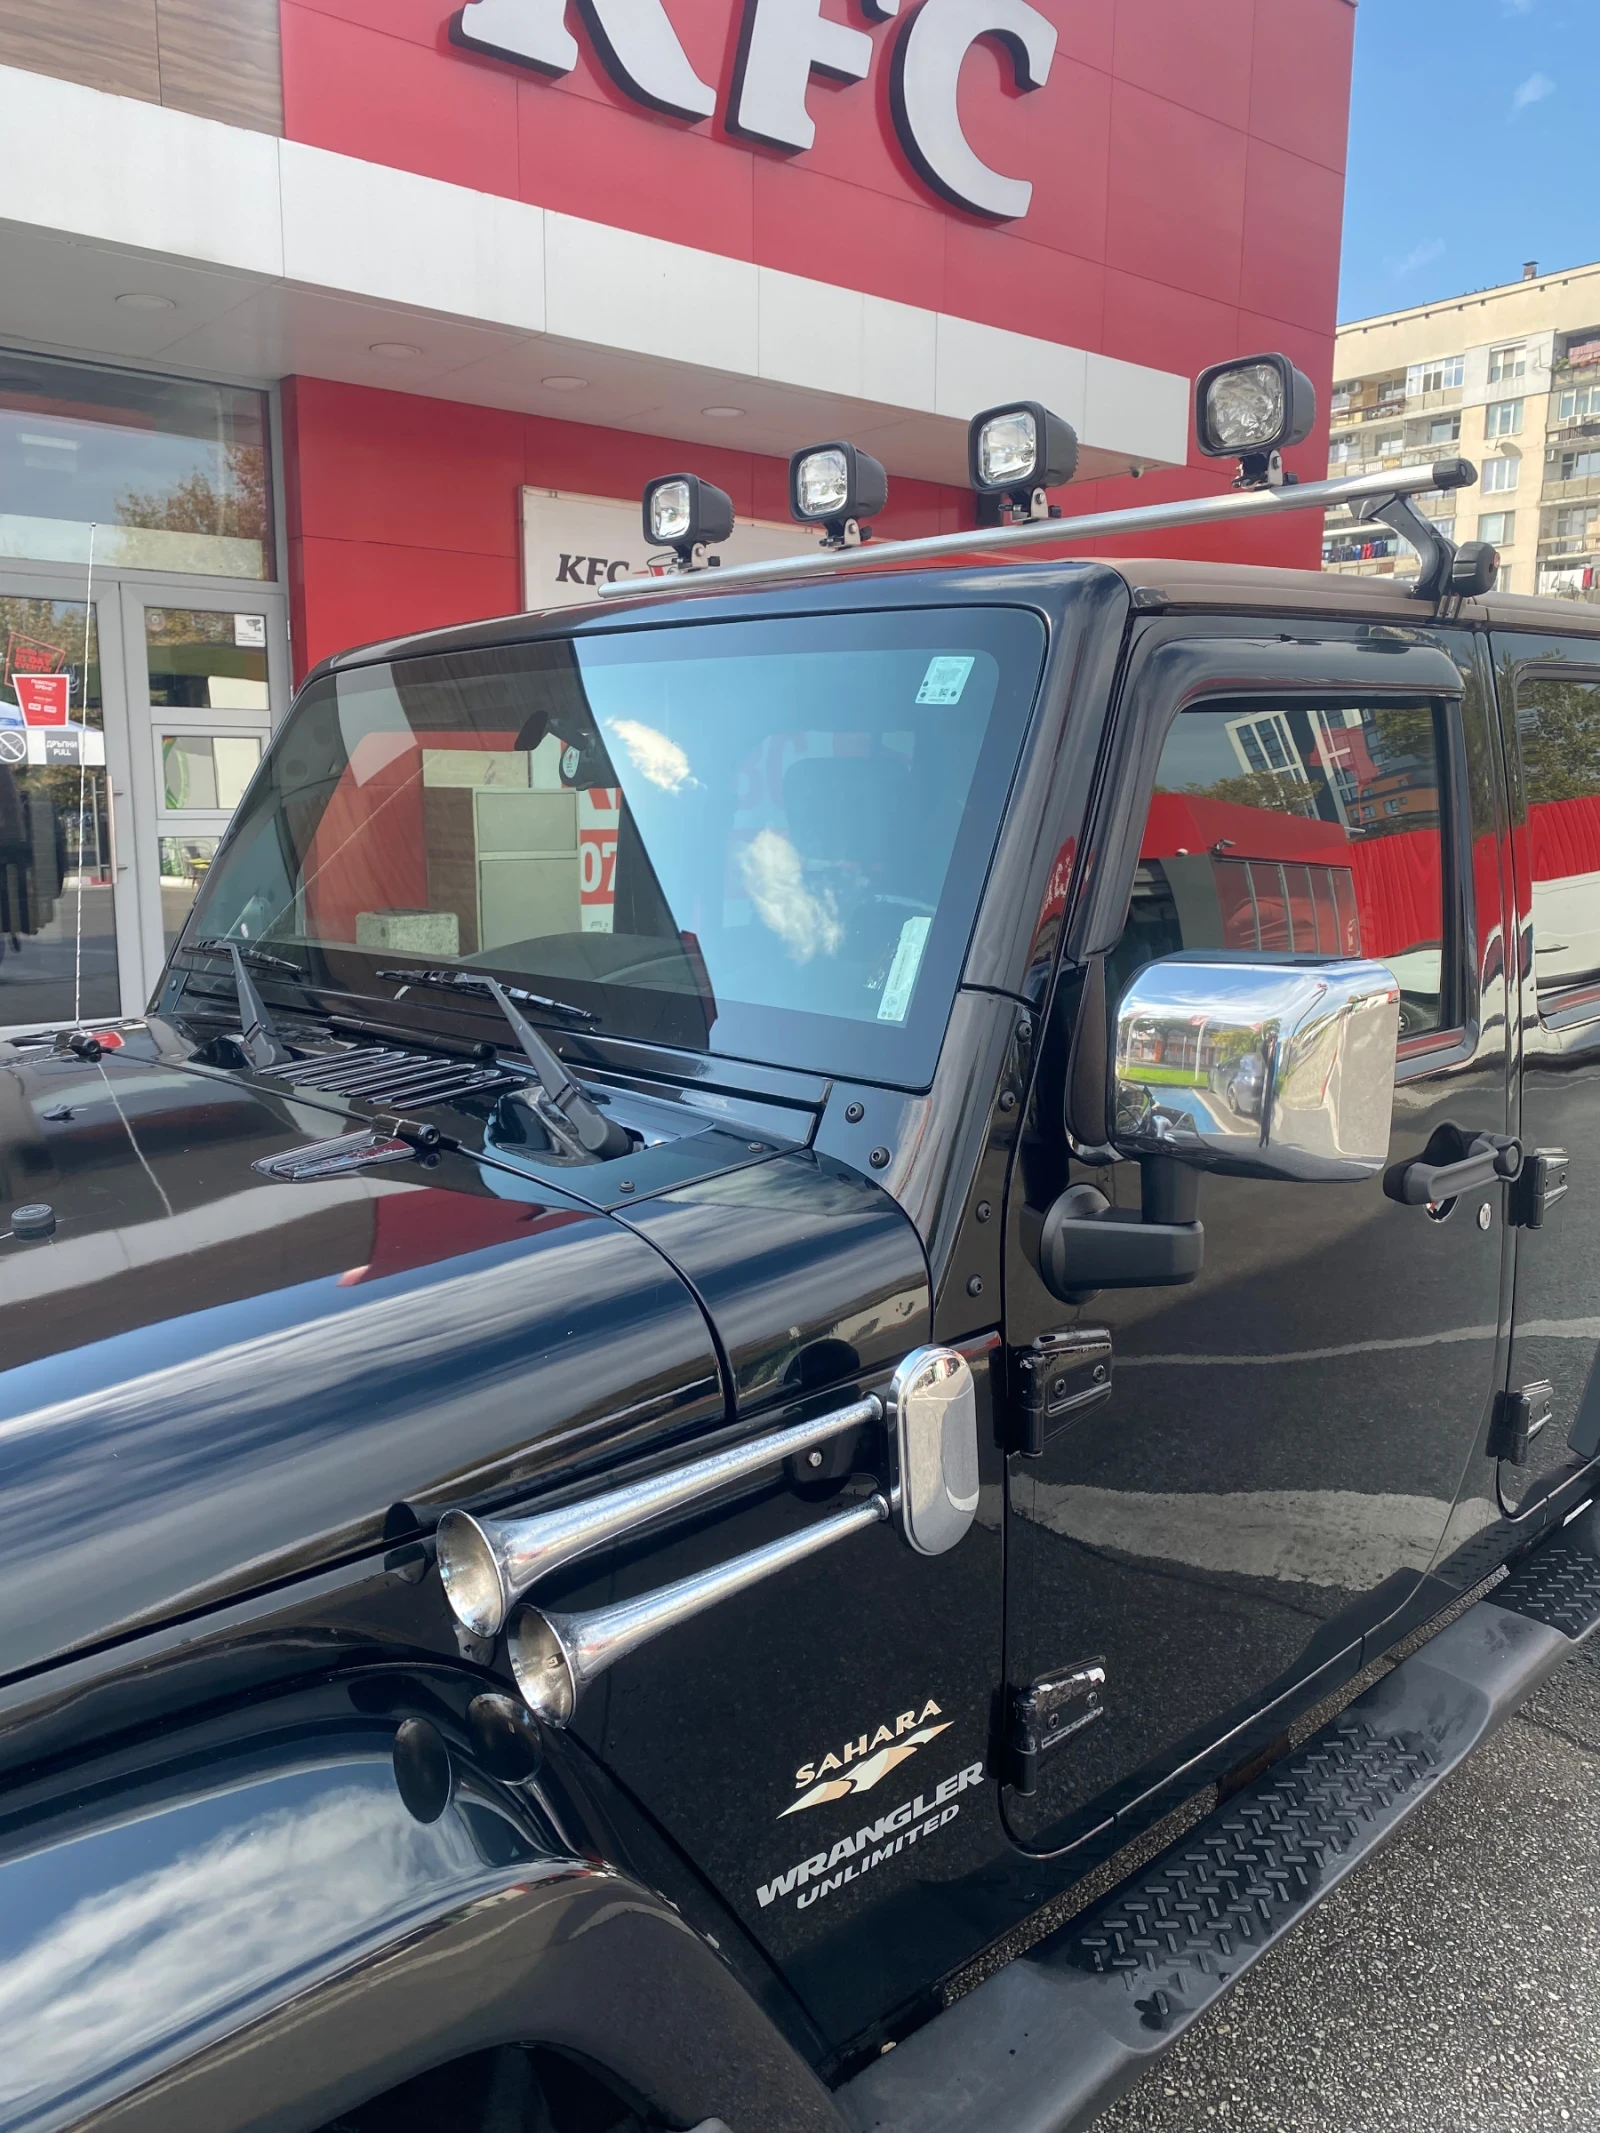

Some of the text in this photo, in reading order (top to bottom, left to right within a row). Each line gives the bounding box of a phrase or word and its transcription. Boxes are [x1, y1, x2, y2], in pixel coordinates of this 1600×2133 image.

[53, 748, 72, 756] PULL
[795, 1699, 943, 1790] SAHARA
[756, 1761, 985, 1908] WRANGLER
[796, 1804, 960, 1910] UNLIMITED
